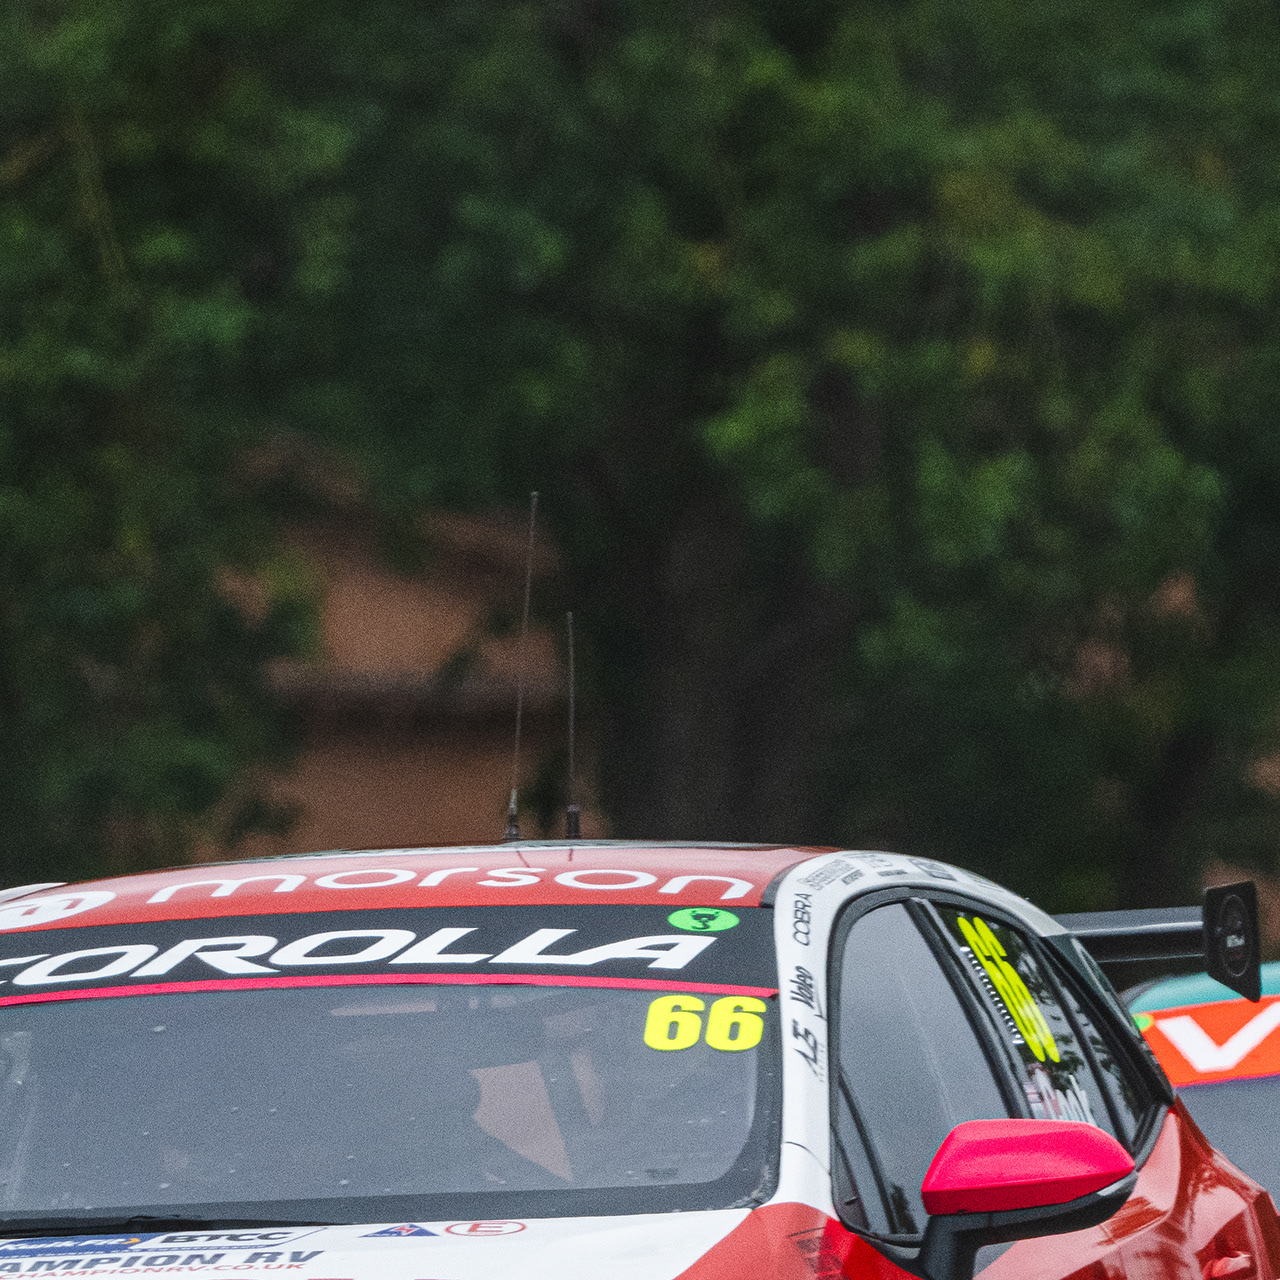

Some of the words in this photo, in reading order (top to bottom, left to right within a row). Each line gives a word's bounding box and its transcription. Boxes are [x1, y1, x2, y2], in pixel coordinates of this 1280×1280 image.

[146, 866, 755, 904] morson
[792, 892, 813, 946] COBRA
[644, 995, 767, 1052] 66
[160, 1232, 294, 1245] BTCC
[240, 1250, 326, 1265] RV
